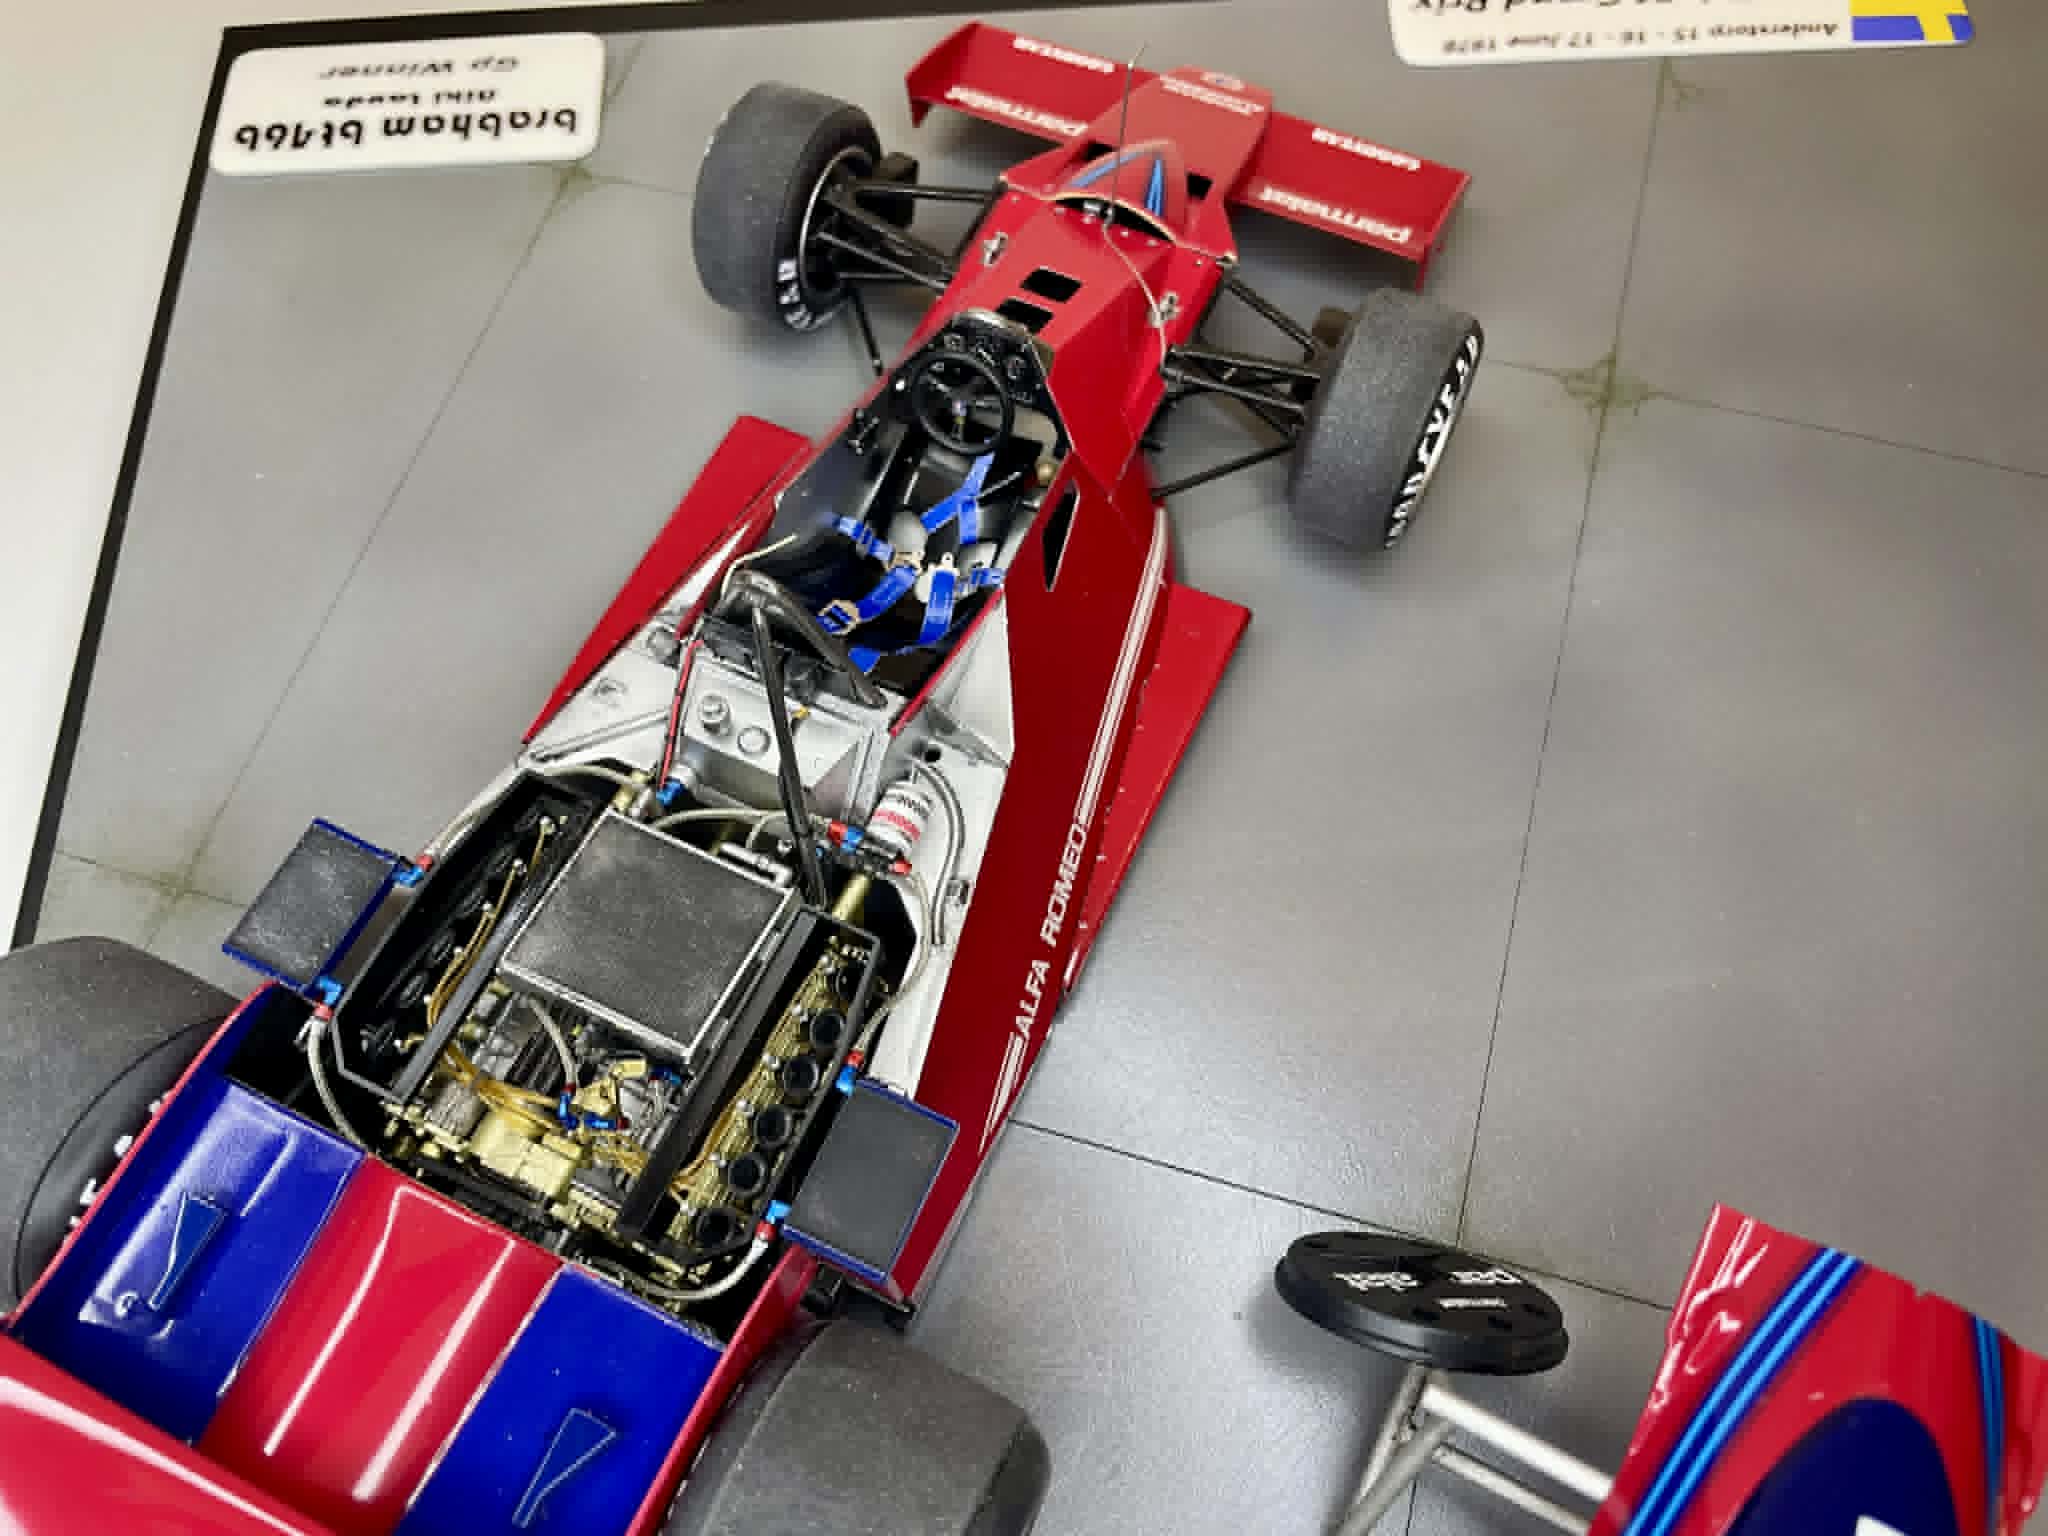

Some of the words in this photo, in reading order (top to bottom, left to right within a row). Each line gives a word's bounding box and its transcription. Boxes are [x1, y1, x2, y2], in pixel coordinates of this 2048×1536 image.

[233, 118, 364, 151] bt46b
[383, 106, 578, 142] brabham
[1258, 184, 1413, 244] parmalat
[1014, 959, 1051, 1043] ALFA
[1039, 822, 1088, 948] ROMEO
